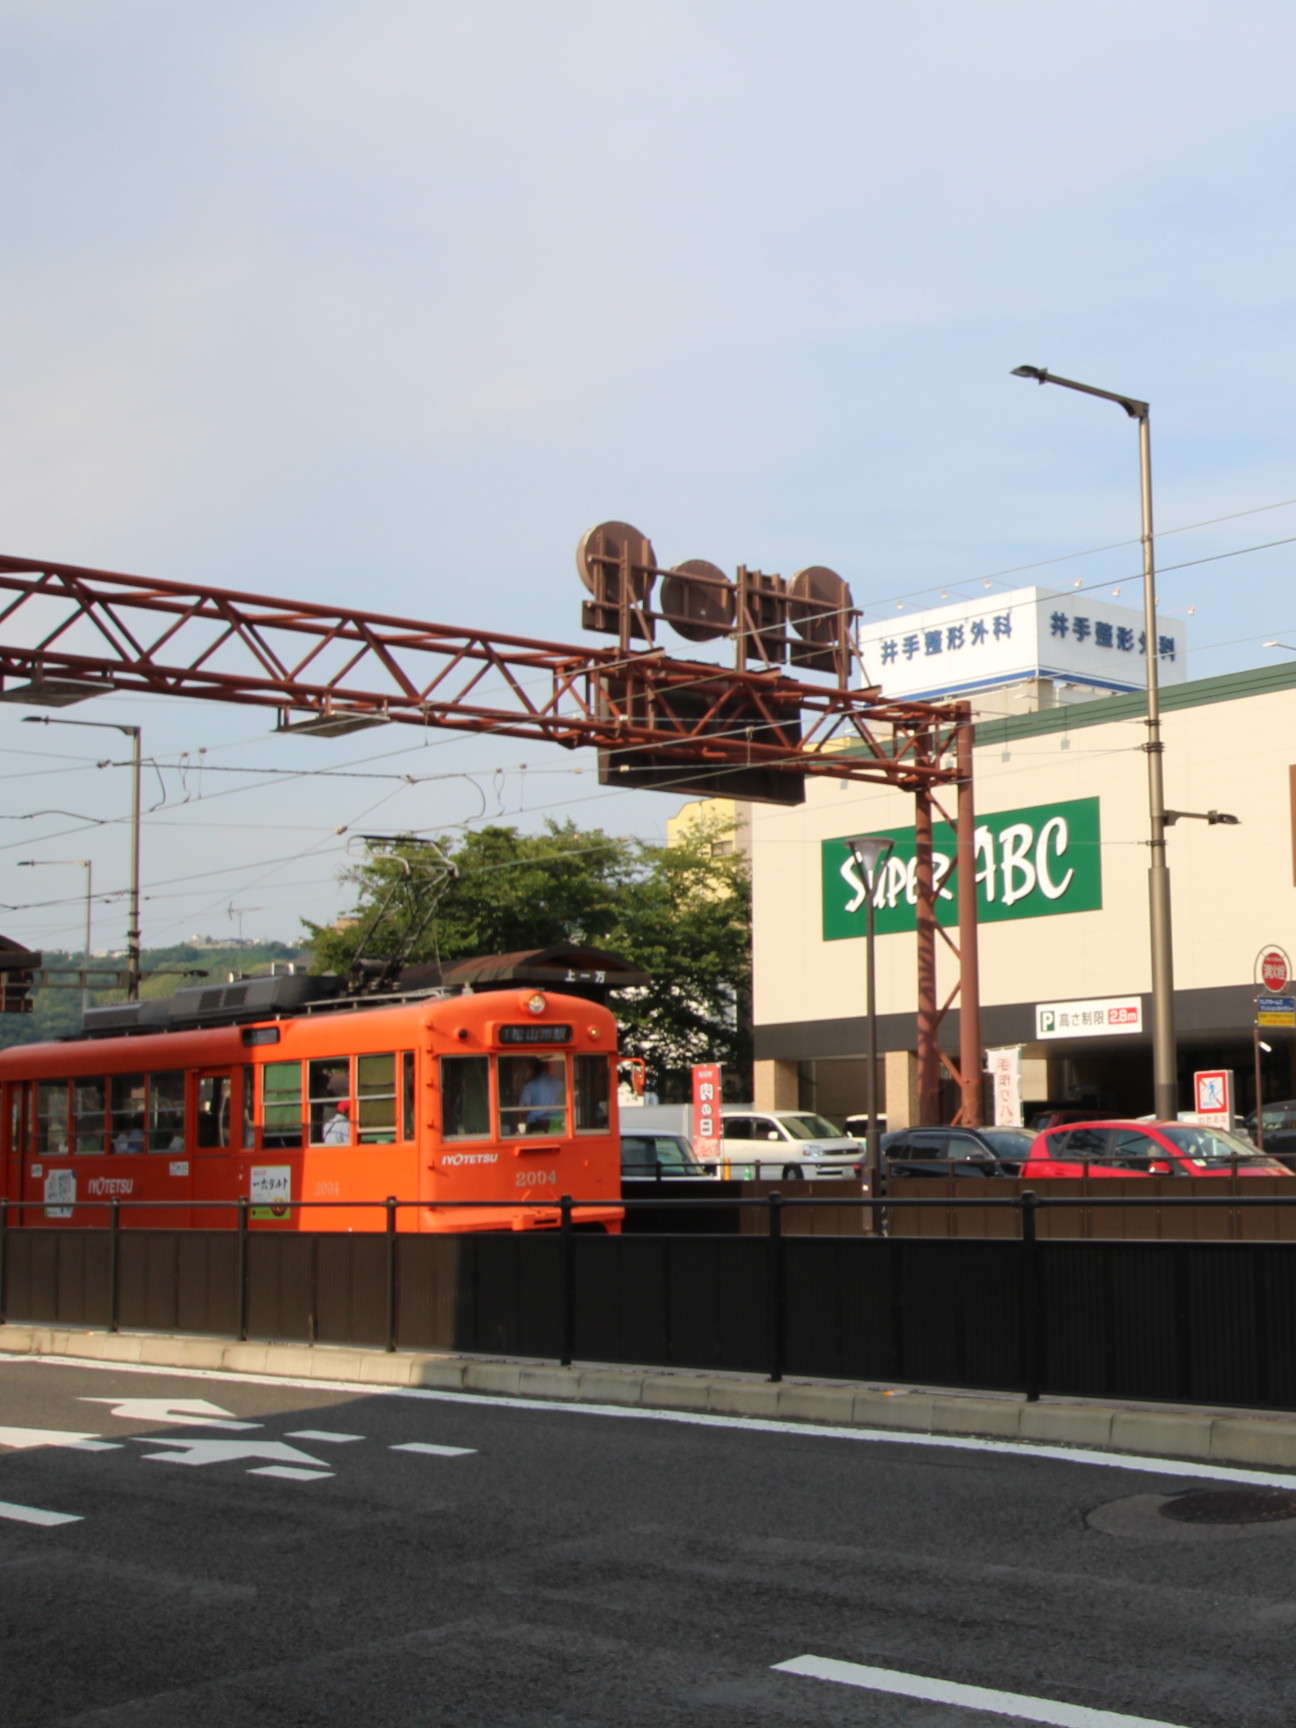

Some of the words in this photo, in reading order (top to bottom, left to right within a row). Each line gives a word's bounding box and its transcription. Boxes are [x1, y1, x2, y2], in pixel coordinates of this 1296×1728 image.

[880, 612, 1013, 666] 井手整形外科
[974, 816, 1074, 907] ABC
[564, 969, 606, 984] 上一万
[1042, 1012, 1054, 1031] P
[1059, 1010, 1105, 1028] 高さ制限
[1109, 1008, 1137, 1023] 2.8m
[442, 1153, 498, 1166] IYOTETSU
[88, 1177, 134, 1195] IYOTETSU
[516, 1170, 557, 1187] 2004
